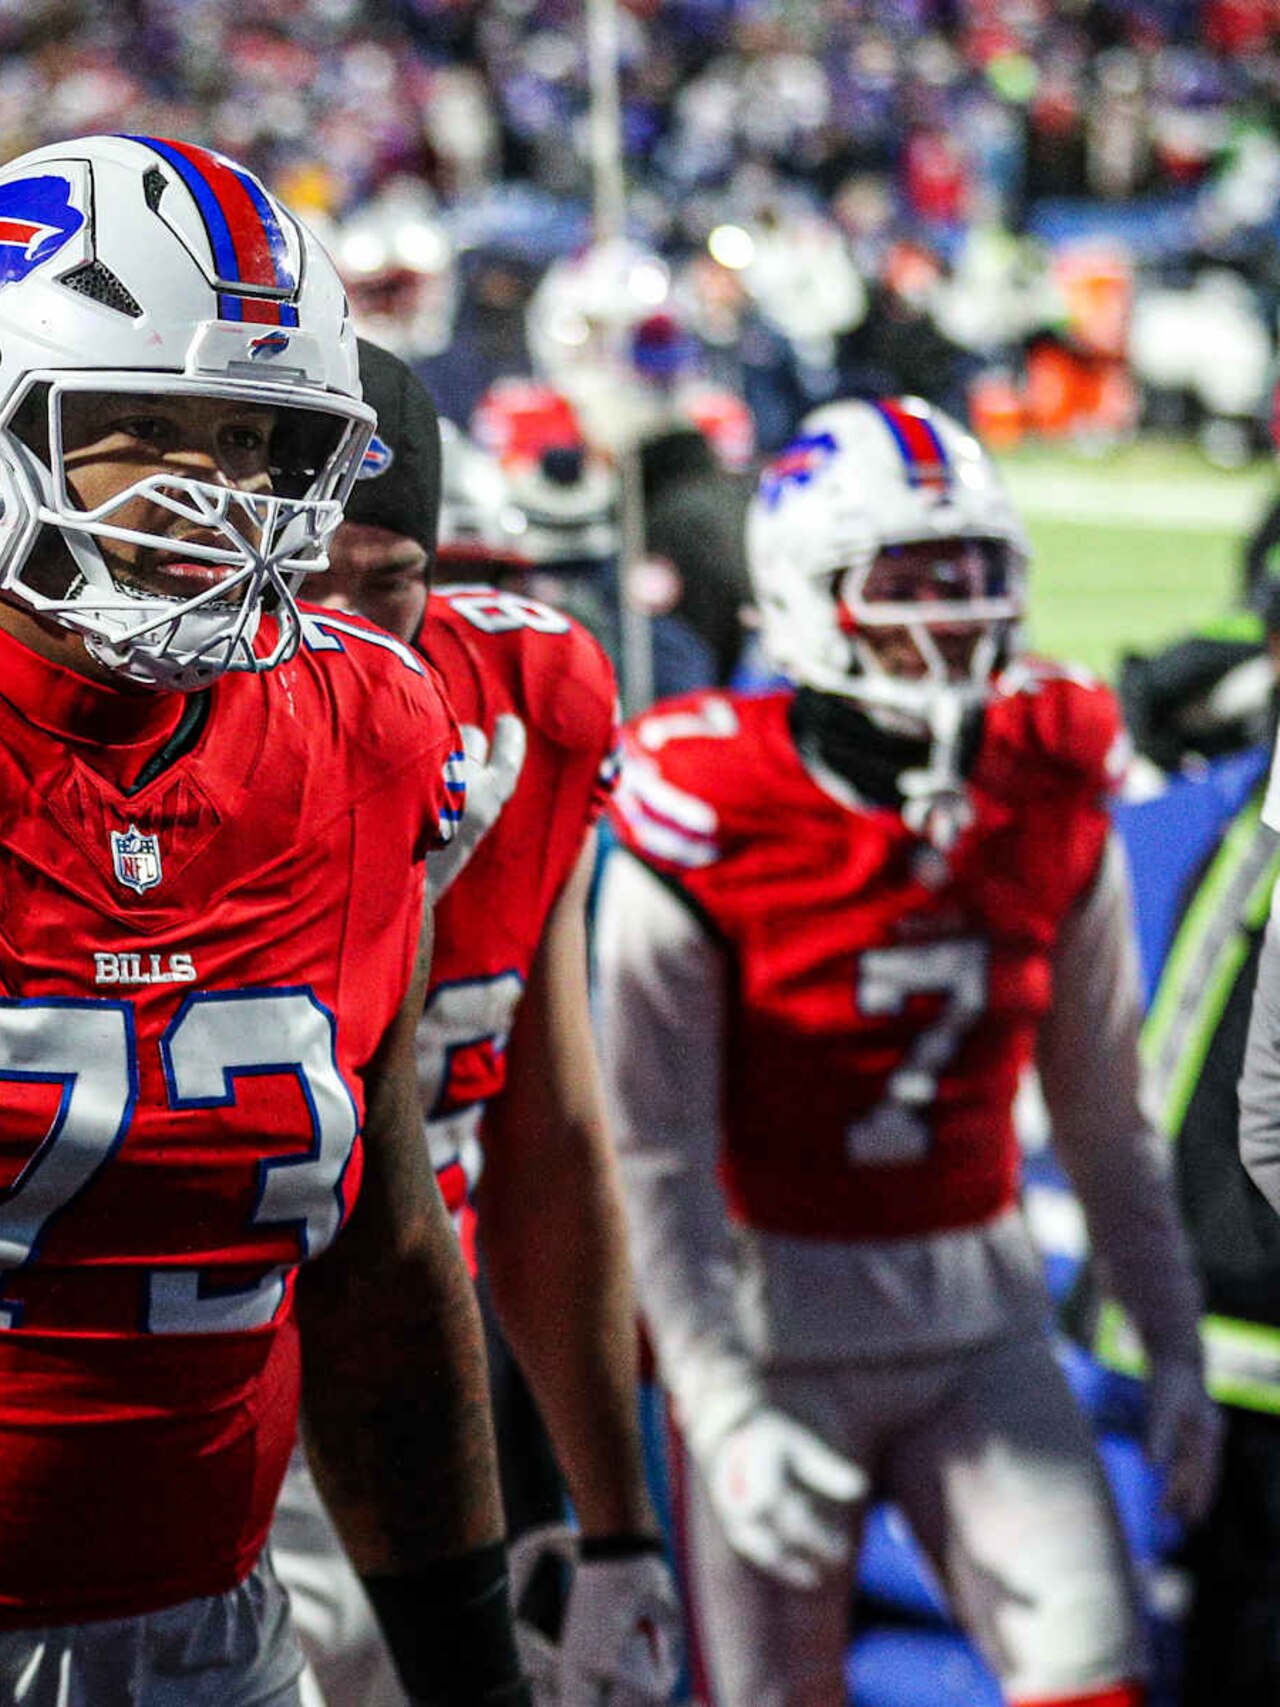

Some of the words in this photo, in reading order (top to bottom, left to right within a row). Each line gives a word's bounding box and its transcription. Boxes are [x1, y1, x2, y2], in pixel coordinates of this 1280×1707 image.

[122, 855, 155, 881] NFL
[94, 952, 197, 984] BILLS
[844, 937, 989, 1168] 7
